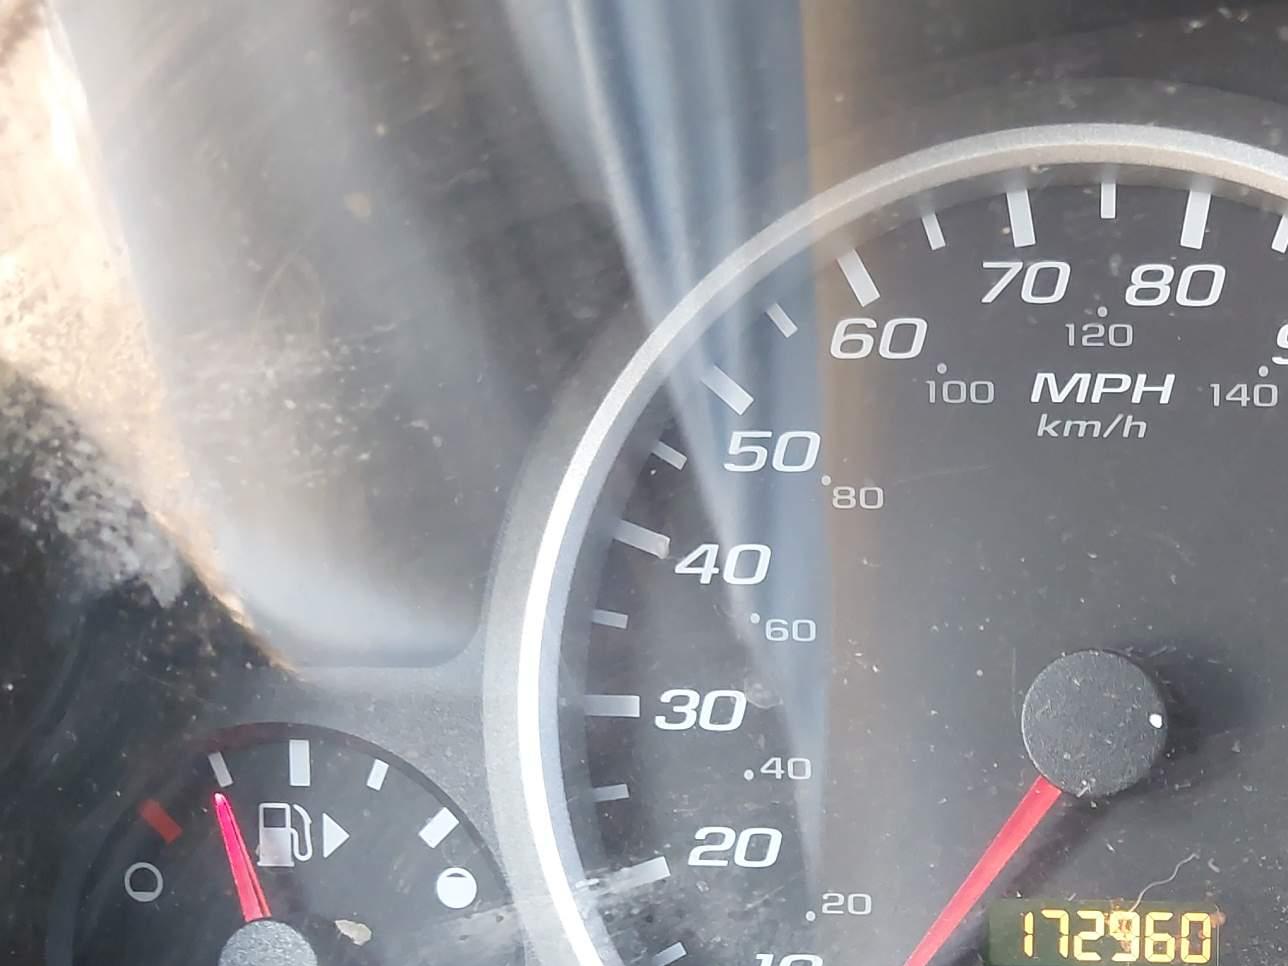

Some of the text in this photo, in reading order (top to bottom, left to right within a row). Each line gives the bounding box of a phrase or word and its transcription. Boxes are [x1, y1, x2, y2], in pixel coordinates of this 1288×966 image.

[981, 261, 1071, 304] 70
[1125, 264, 1226, 307] 80
[830, 317, 928, 360] 60
[1065, 323, 1134, 347] 120
[925, 380, 995, 404] 100
[1031, 373, 1176, 404] MPH
[1209, 383, 1279, 407] 140
[1036, 413, 1148, 438] km/h
[723, 430, 821, 473] 50
[831, 486, 885, 510] 80
[674, 543, 772, 585] 40
[765, 619, 817, 642] 60
[654, 689, 748, 731] 30
[759, 756, 812, 780] 40
[687, 826, 783, 867] 20
[821, 893, 873, 916] 20
[1021, 908, 1212, 964] 172960
